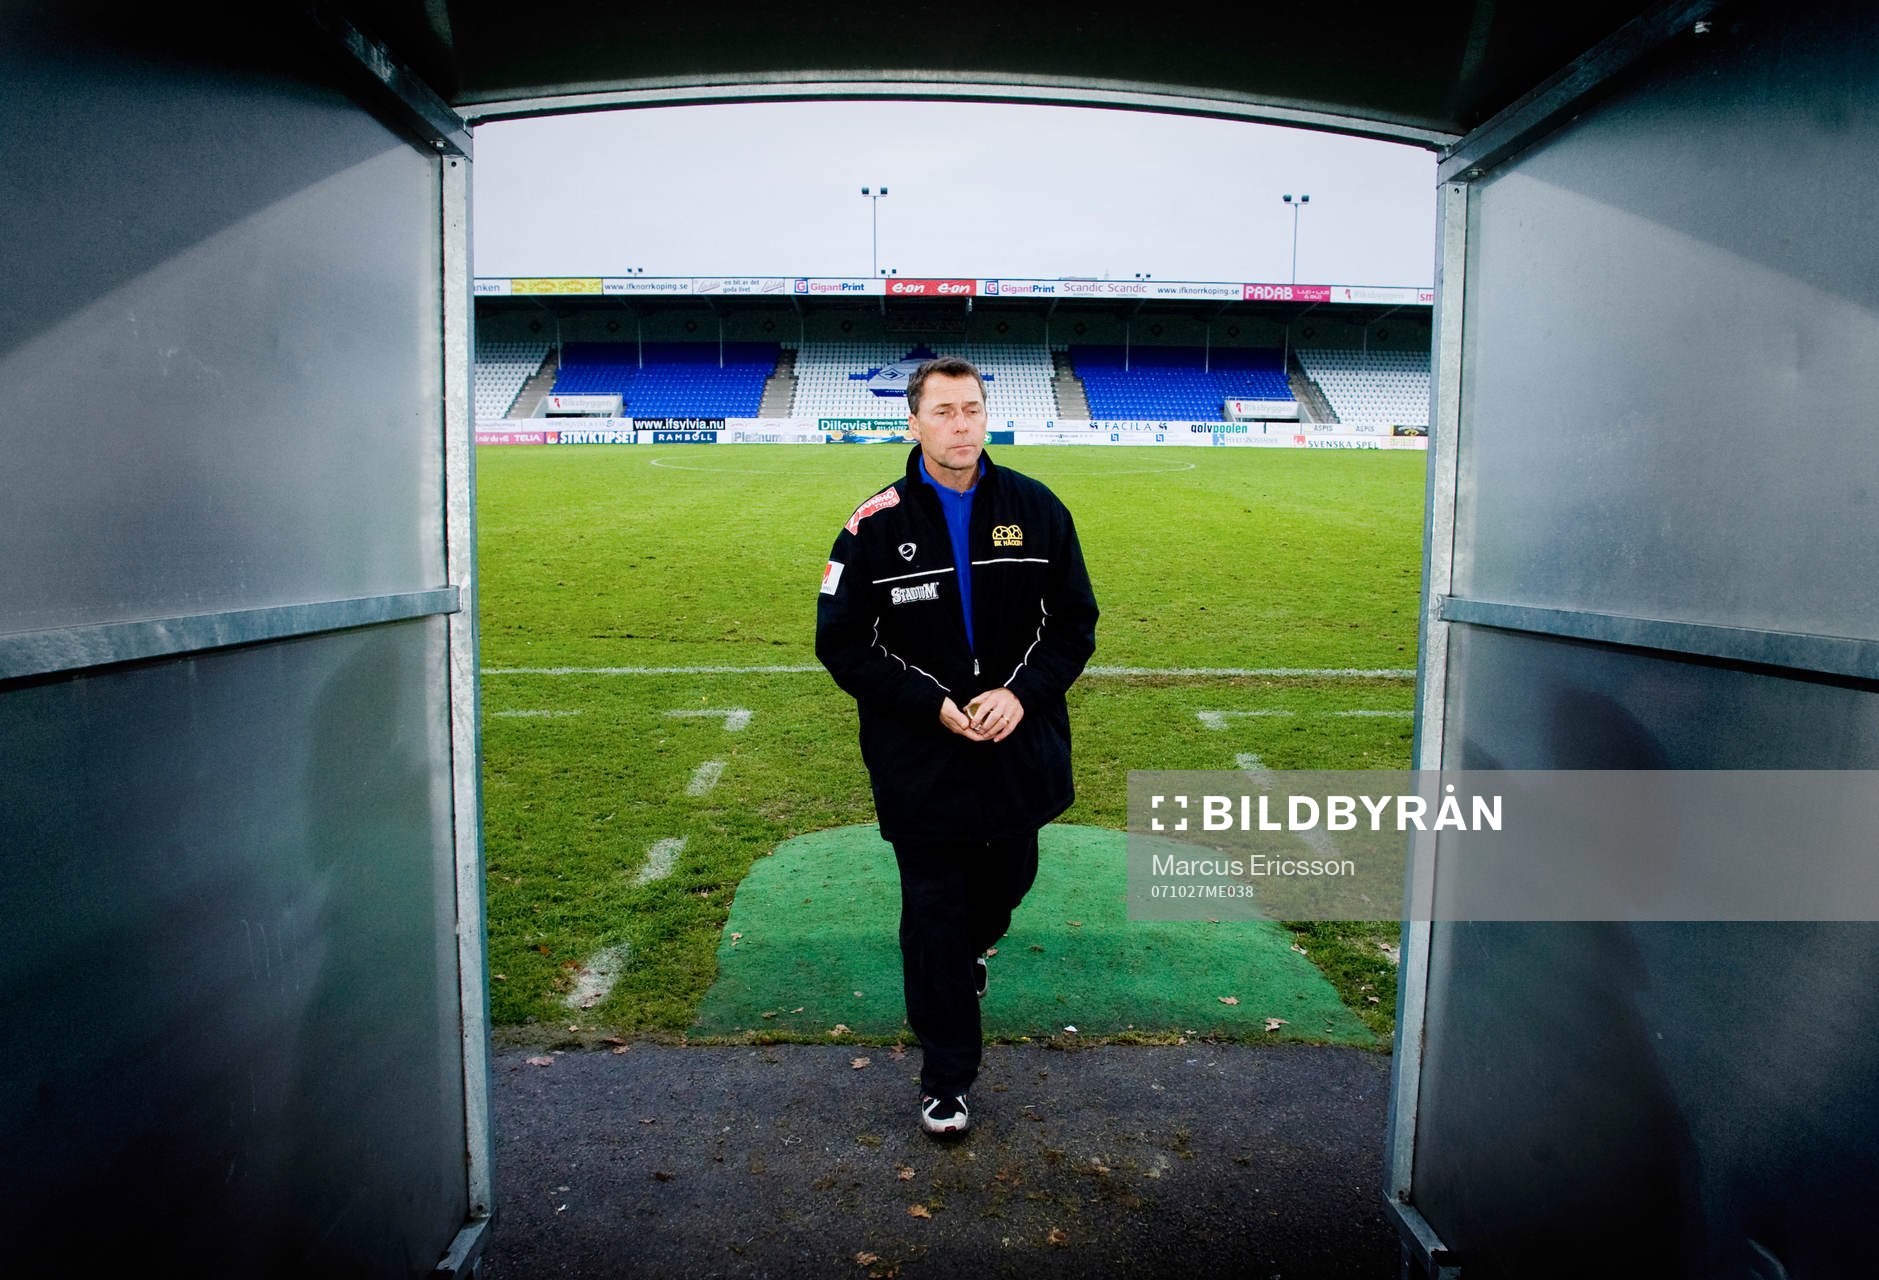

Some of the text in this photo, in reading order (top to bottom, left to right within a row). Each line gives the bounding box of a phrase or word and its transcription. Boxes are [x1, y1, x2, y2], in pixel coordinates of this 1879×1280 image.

[810, 282, 865, 293] GigantPrint
[1001, 283, 1055, 294] GigantPrint
[1063, 282, 1103, 292] Scandic
[1107, 283, 1147, 293] Scandic
[1157, 286, 1240, 297] www.ifknorrkoping.se
[1245, 286, 1293, 300] PADAB
[634, 418, 725, 431] www.ifsylvia.nu
[820, 420, 872, 431] Dillqvist
[1104, 421, 1152, 431] FACILA
[560, 431, 636, 444] STRYKTIPSET
[1308, 440, 1379, 450] SVENSKA SPEL
[890, 581, 940, 606] STADIUM
